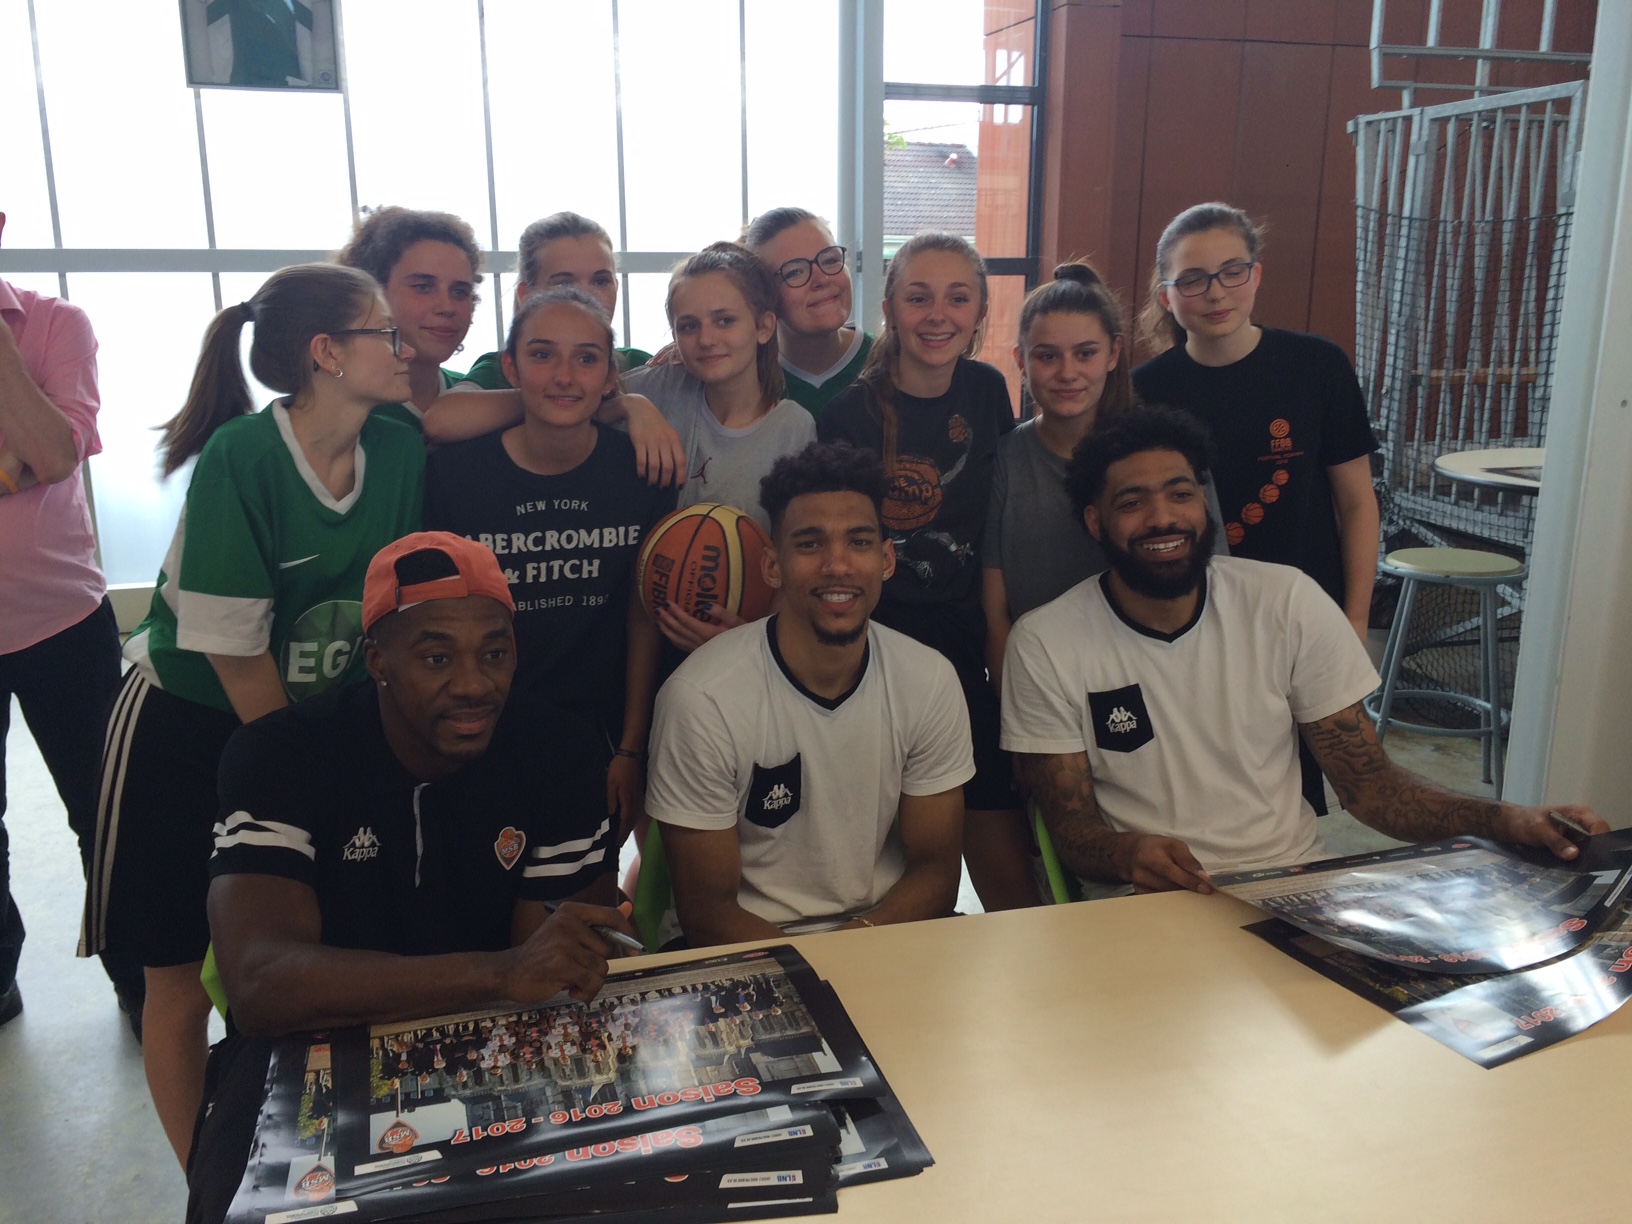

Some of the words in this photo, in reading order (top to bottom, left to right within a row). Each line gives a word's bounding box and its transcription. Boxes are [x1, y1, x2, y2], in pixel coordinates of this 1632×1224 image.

[516, 501, 546, 515] NEW
[553, 500, 588, 511] YORK
[466, 525, 641, 554] BERCROMBIE
[504, 569, 520, 584] &
[526, 559, 600, 583] FITCH
[287, 636, 363, 682] EG
[1108, 720, 1137, 733] Kappa
[763, 797, 791, 810] Kappa
[343, 847, 378, 862] Kappa
[1513, 1006, 1562, 1031] 2017
[631, 1077, 762, 1111] Saison
[550, 1100, 623, 1126] 2016
[384, 1128, 411, 1145] MSB
[450, 1117, 526, 1145] 2017
[787, 1129, 802, 1137] LNB
[565, 1126, 703, 1163] Saison
[301, 1173, 329, 1189] MSB
[776, 1174, 791, 1183] LNB
